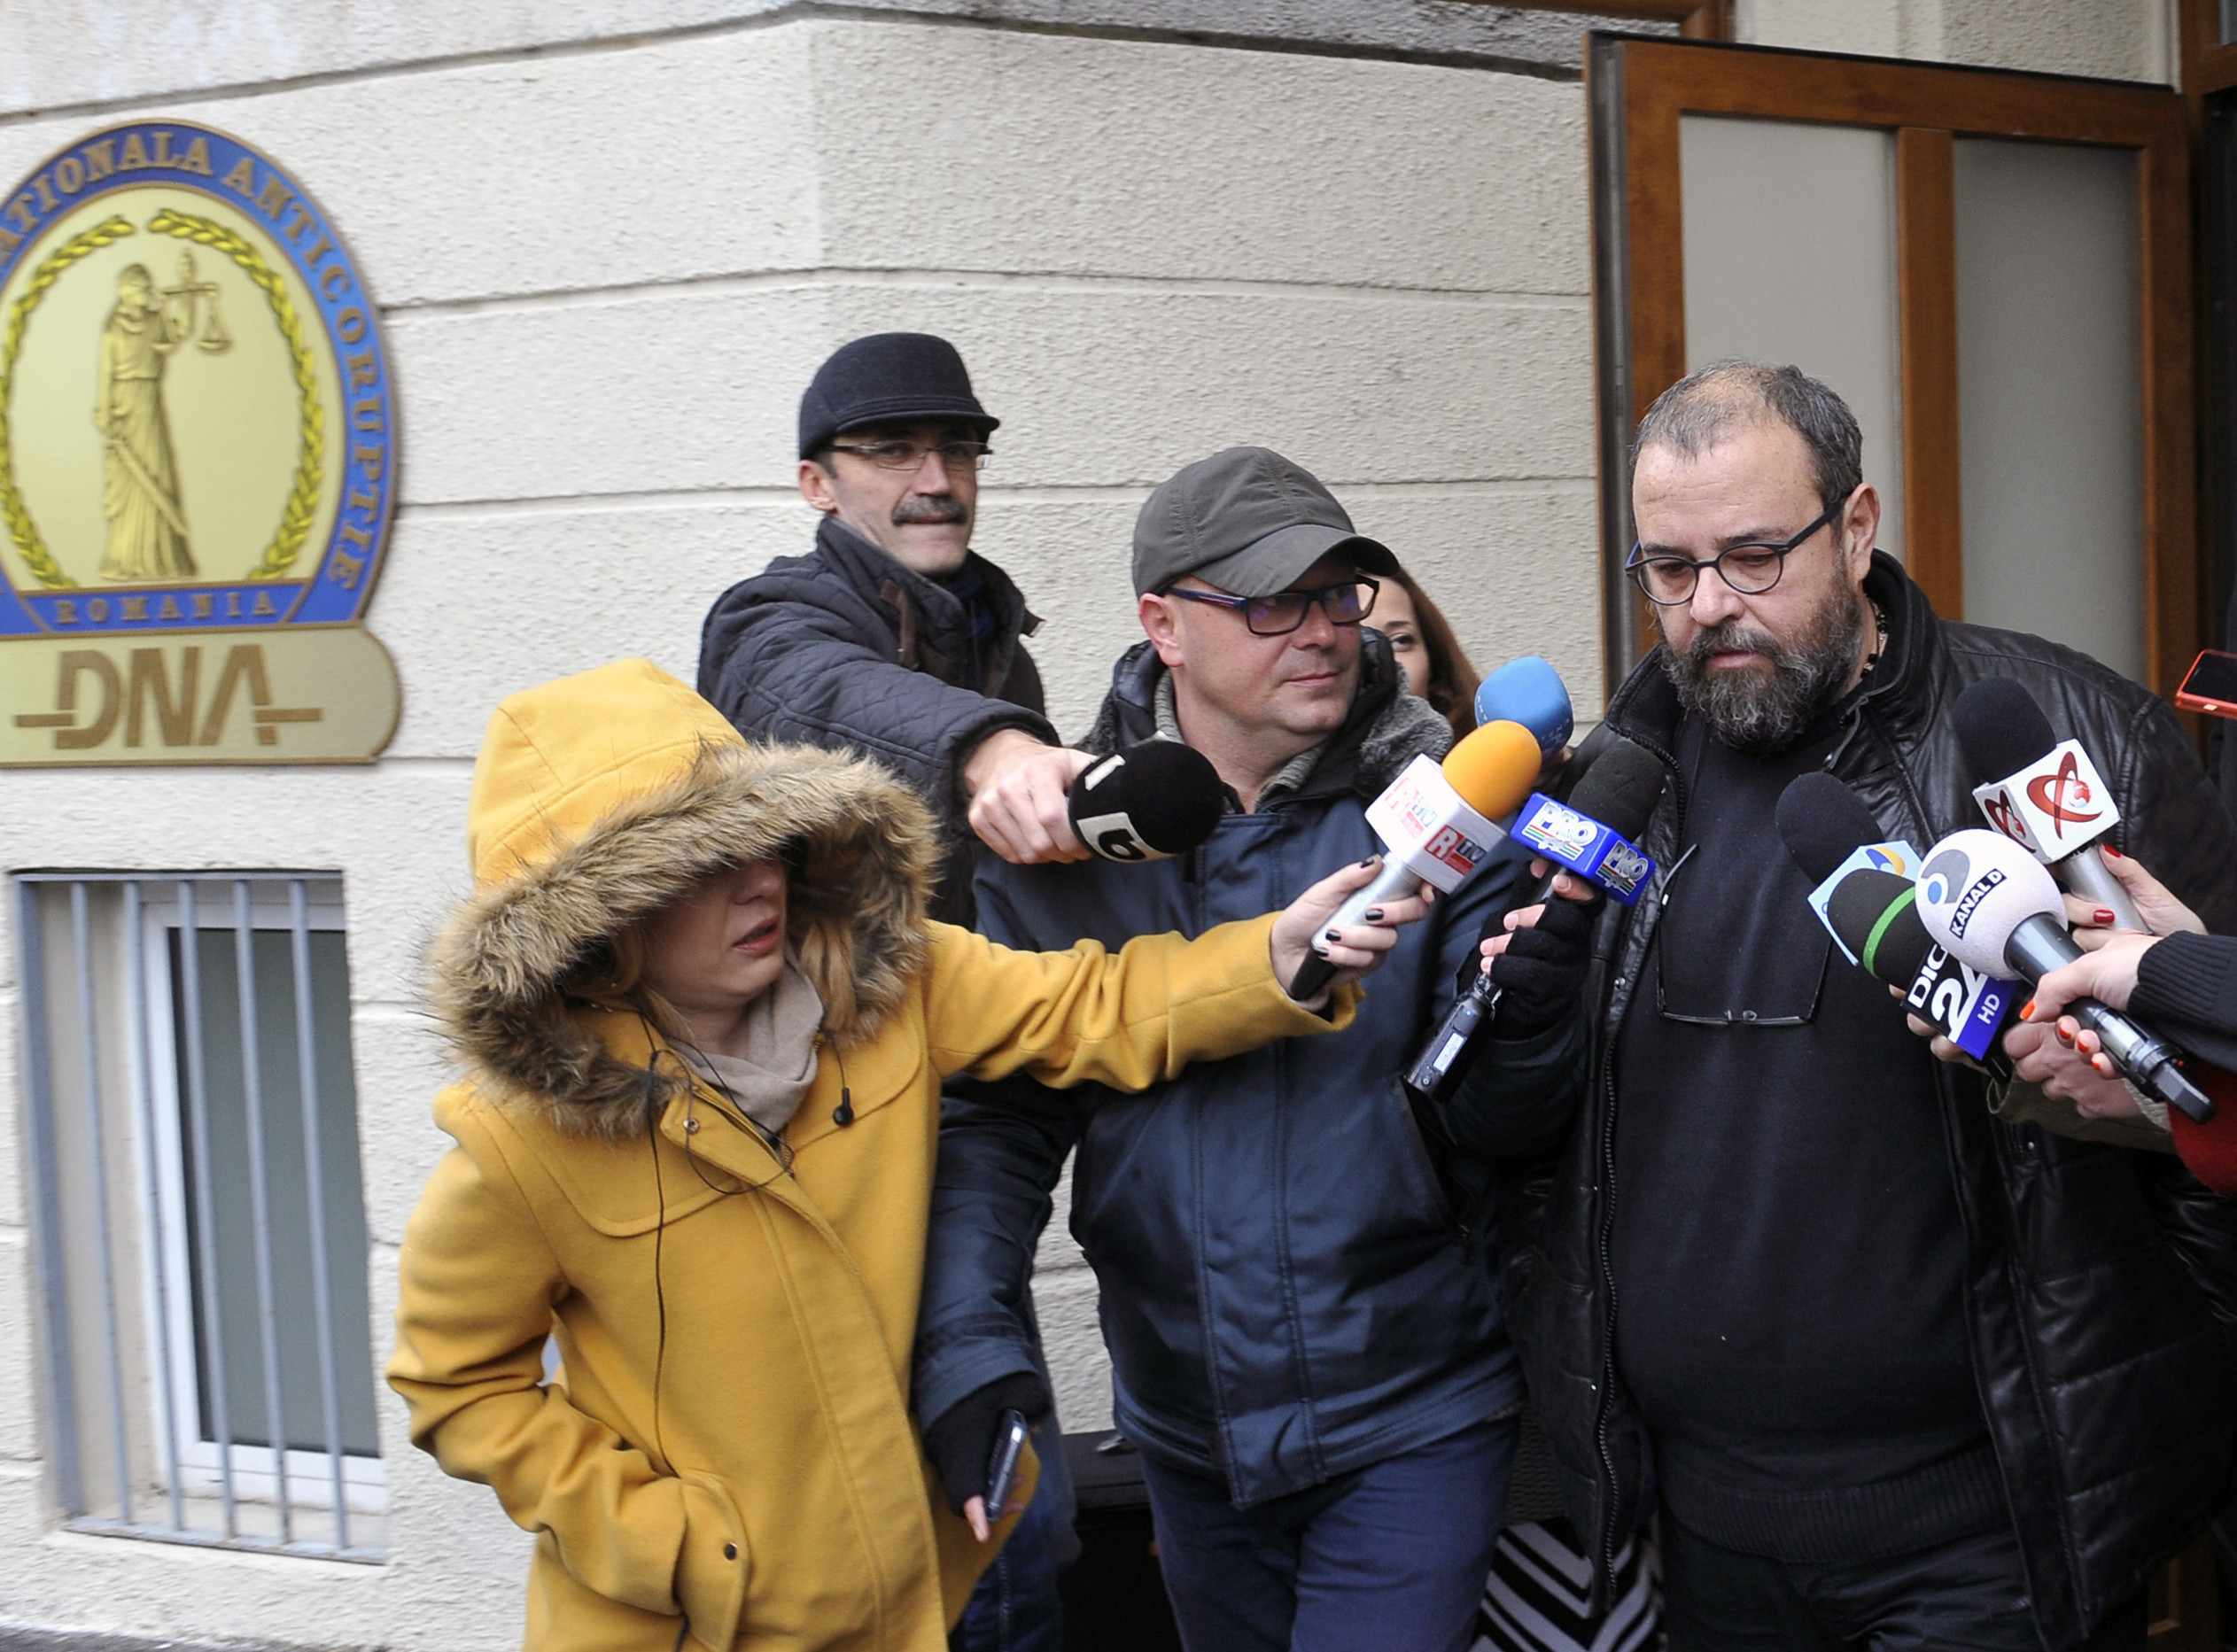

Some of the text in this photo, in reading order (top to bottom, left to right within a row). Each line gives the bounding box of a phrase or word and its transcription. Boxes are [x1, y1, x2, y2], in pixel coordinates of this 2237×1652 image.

[221, 157, 384, 591] ANTICORUPTIE
[53, 591, 277, 625] ROMANIA
[54, 643, 279, 750] DNA
[1530, 801, 1598, 847] PRO
[1603, 840, 1649, 881] PRO
[1951, 870, 2003, 937] KANAL D
[1977, 993, 2000, 1025] HD
